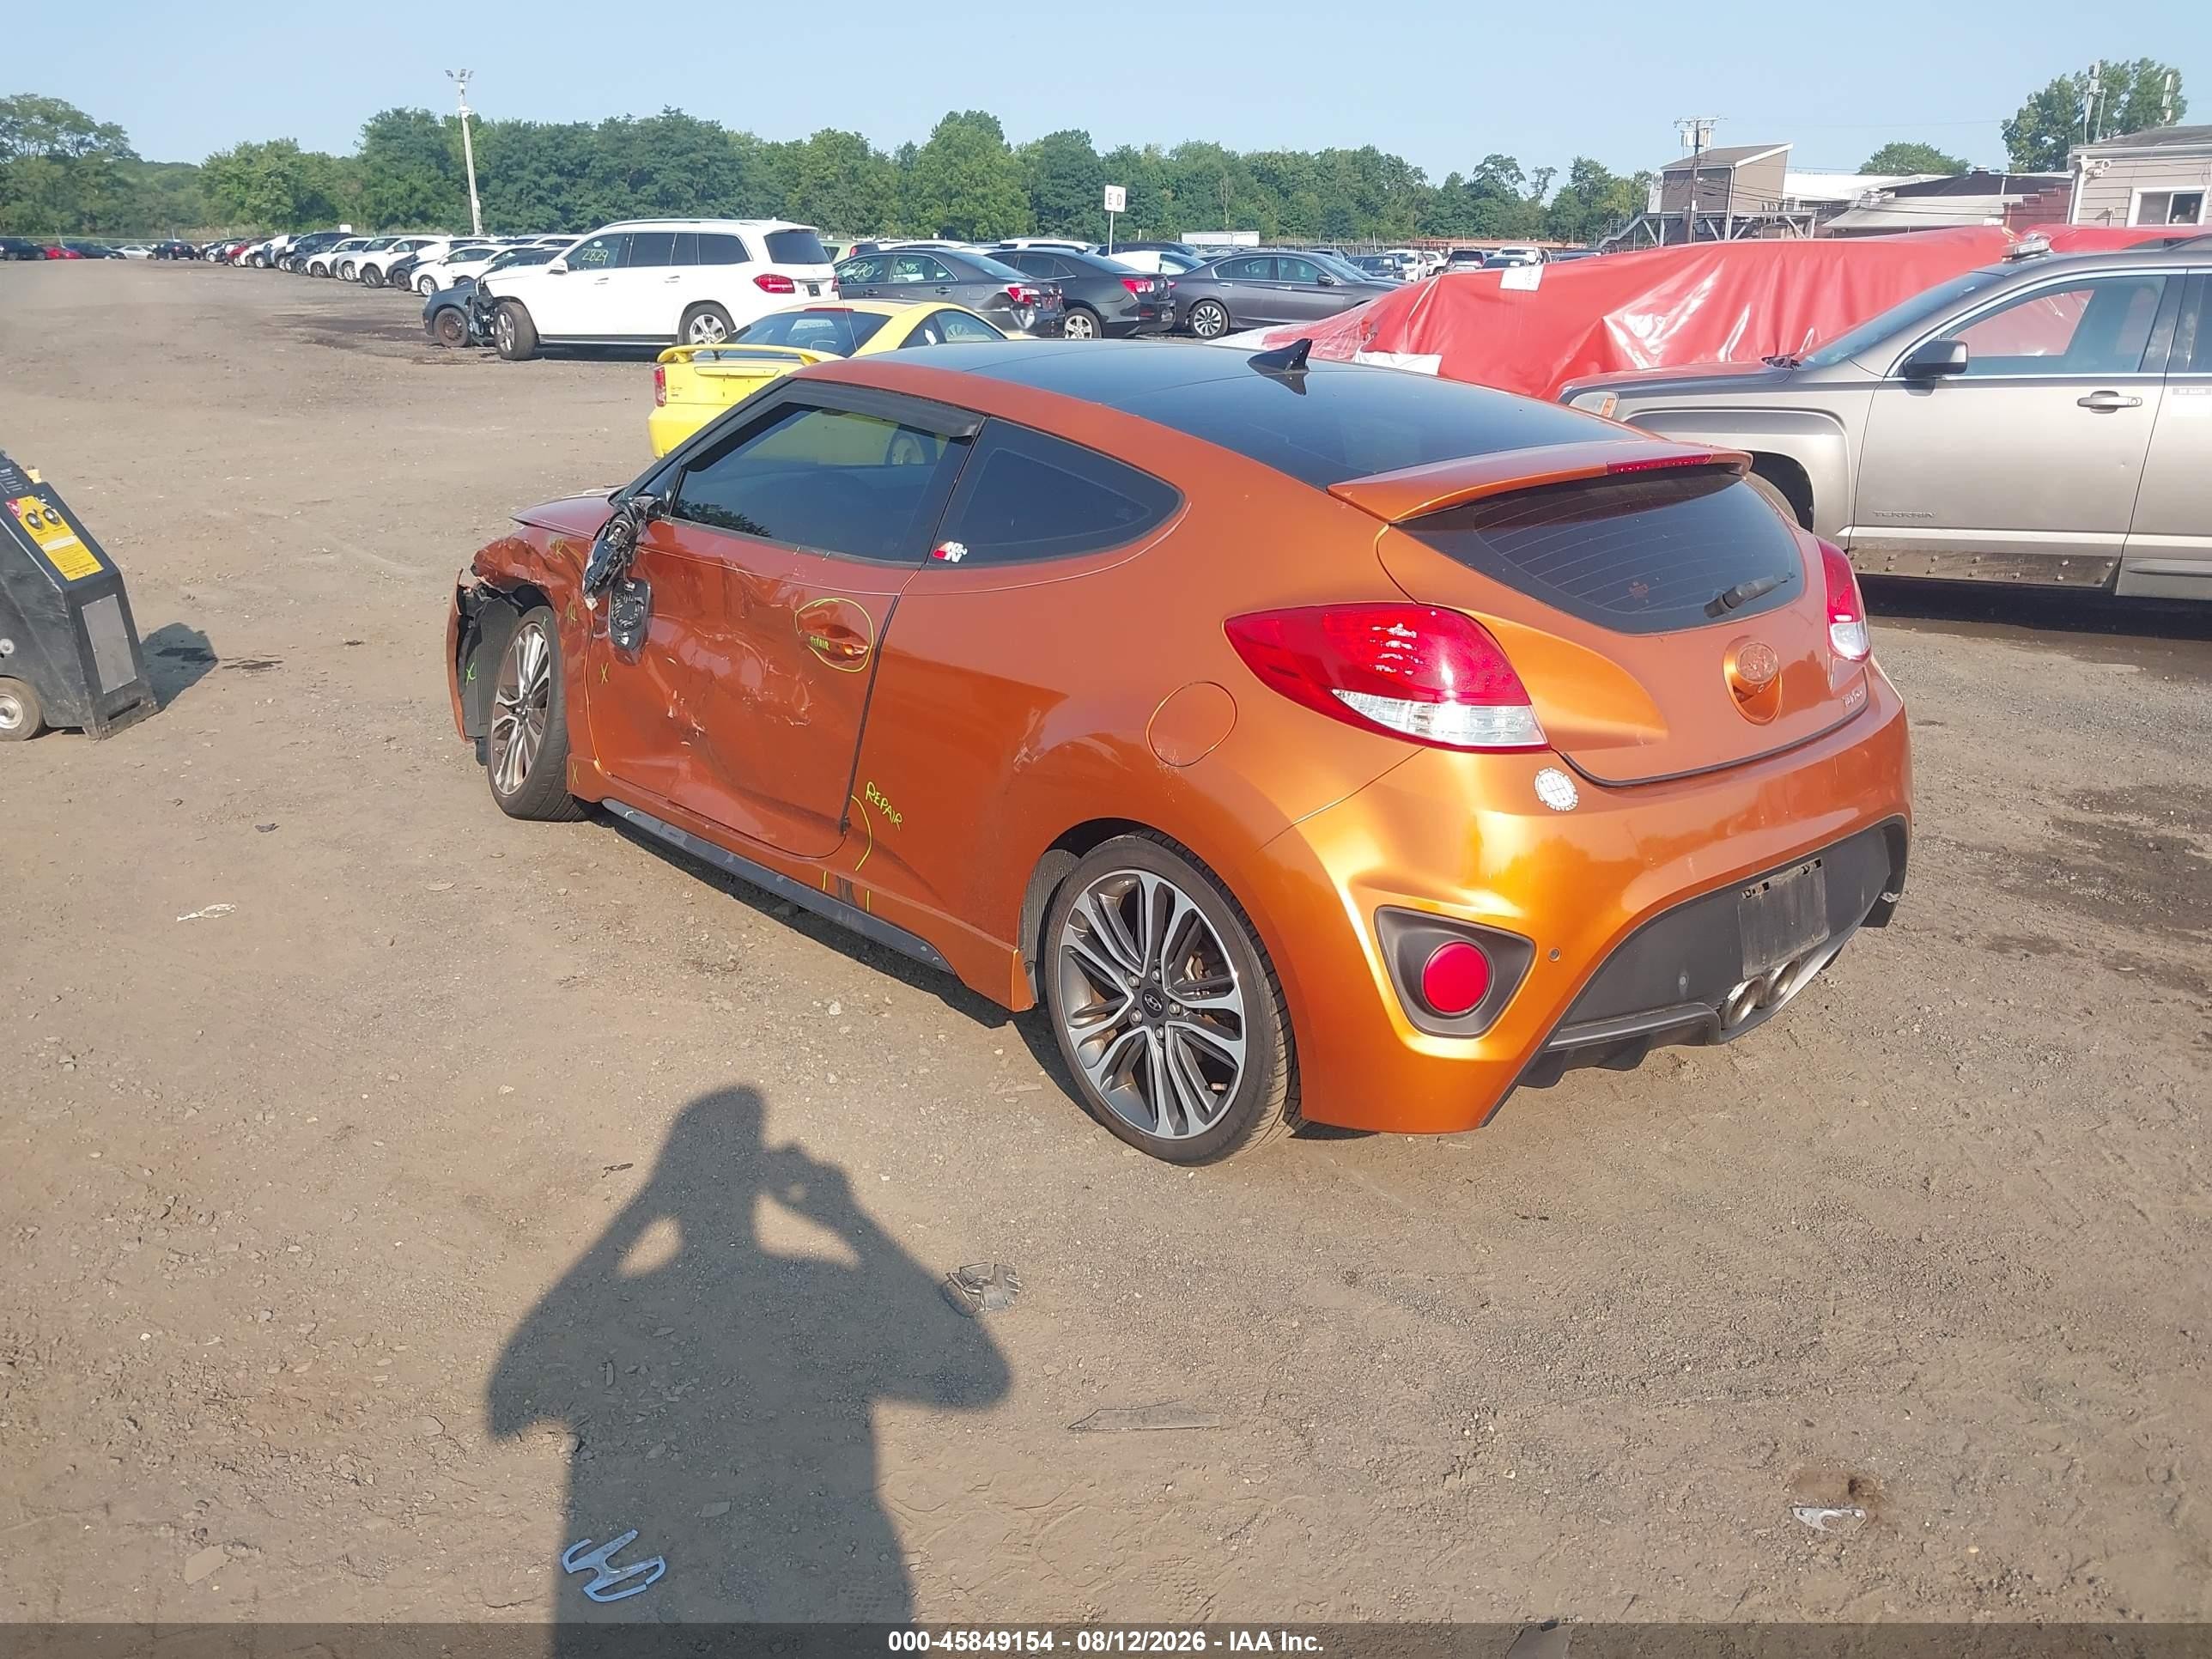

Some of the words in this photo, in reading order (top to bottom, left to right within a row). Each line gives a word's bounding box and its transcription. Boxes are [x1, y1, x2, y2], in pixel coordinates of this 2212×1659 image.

[1108, 192, 1113, 205] E
[582, 248, 609, 265] 2829
[866, 781, 902, 831] REPAIR
